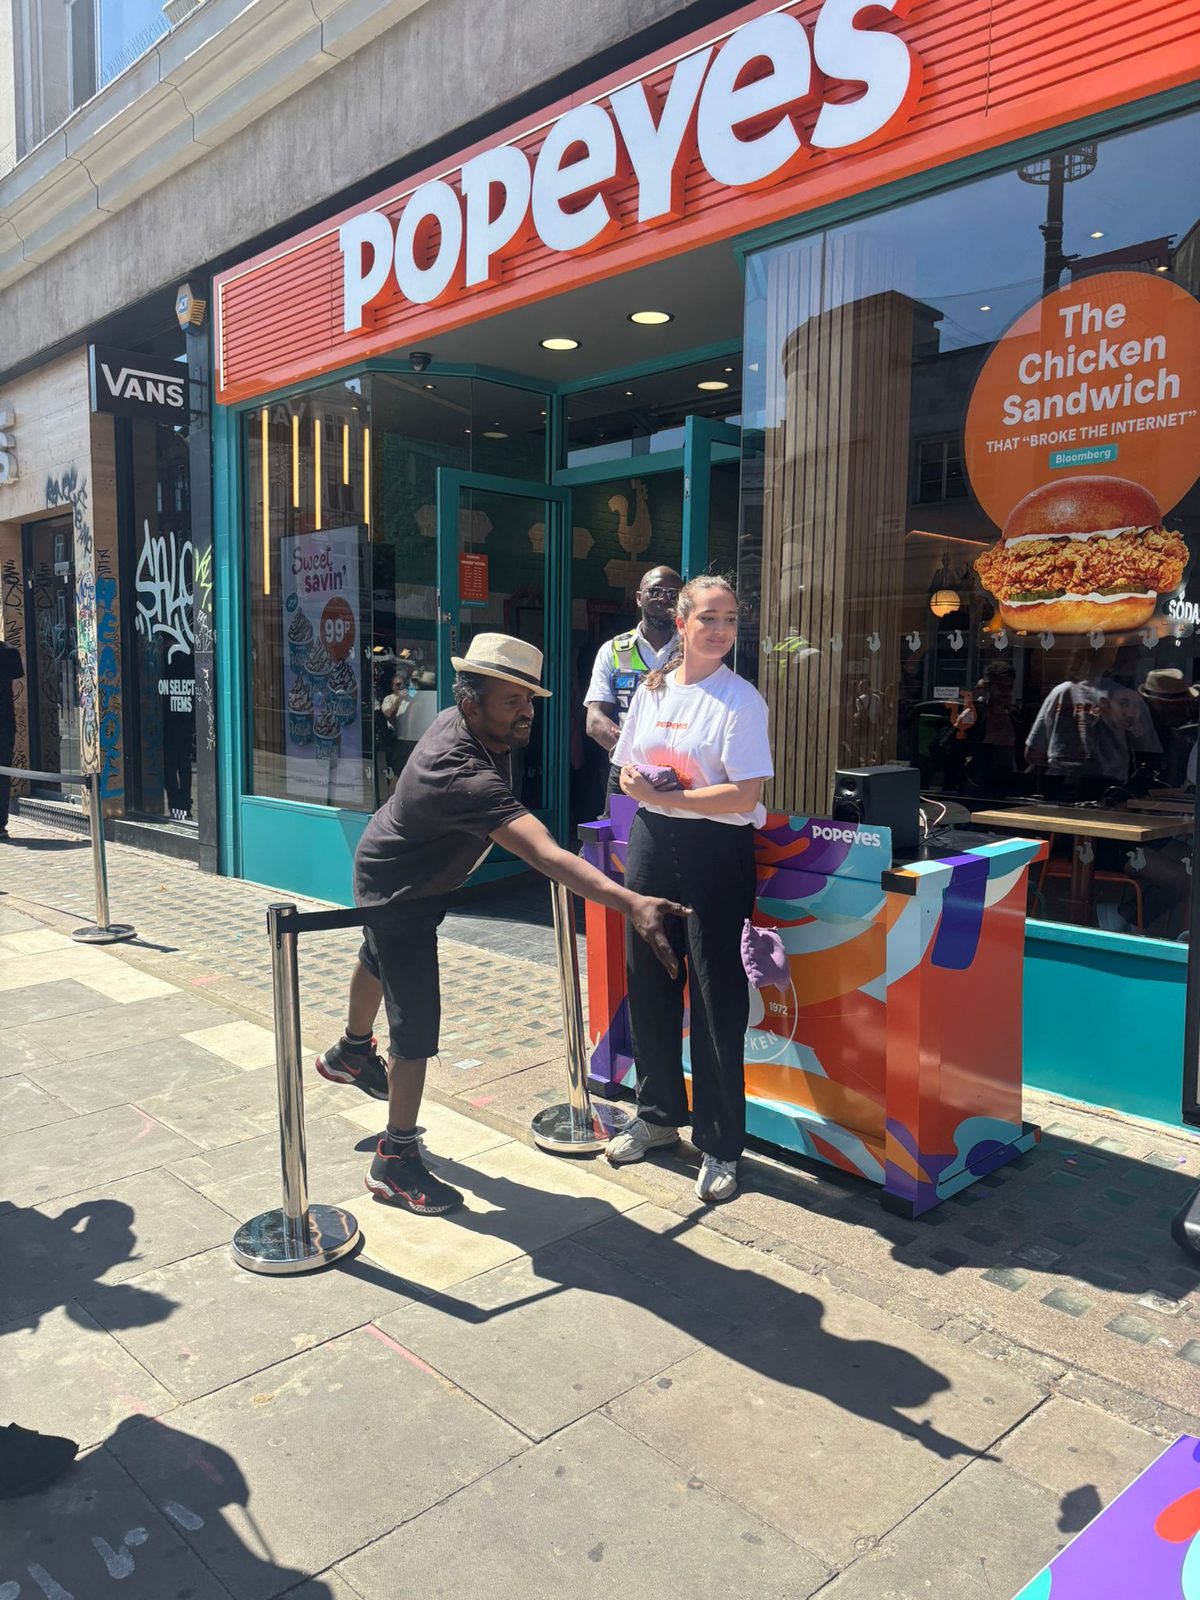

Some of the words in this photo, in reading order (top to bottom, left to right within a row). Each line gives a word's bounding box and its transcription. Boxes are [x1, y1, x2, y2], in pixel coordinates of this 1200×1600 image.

[1058, 302, 1127, 338] The
[1018, 335, 1167, 385] Chicken
[100, 363, 185, 408] VANS
[1002, 368, 1181, 426] Sandwich
[986, 437, 1020, 454] THAT
[1023, 428, 1077, 447] “BROKE
[1080, 424, 1108, 440] THE
[1111, 410, 1198, 435] INTERNET”
[1055, 449, 1112, 465] Bloomberg
[292, 545, 334, 575] Sweet
[158, 679, 169, 695] ON
[169, 679, 195, 696] SELECT
[170, 697, 192, 713] ITEMS
[768, 1002, 788, 1016] 1972
[744, 1029, 779, 1052] KEN
